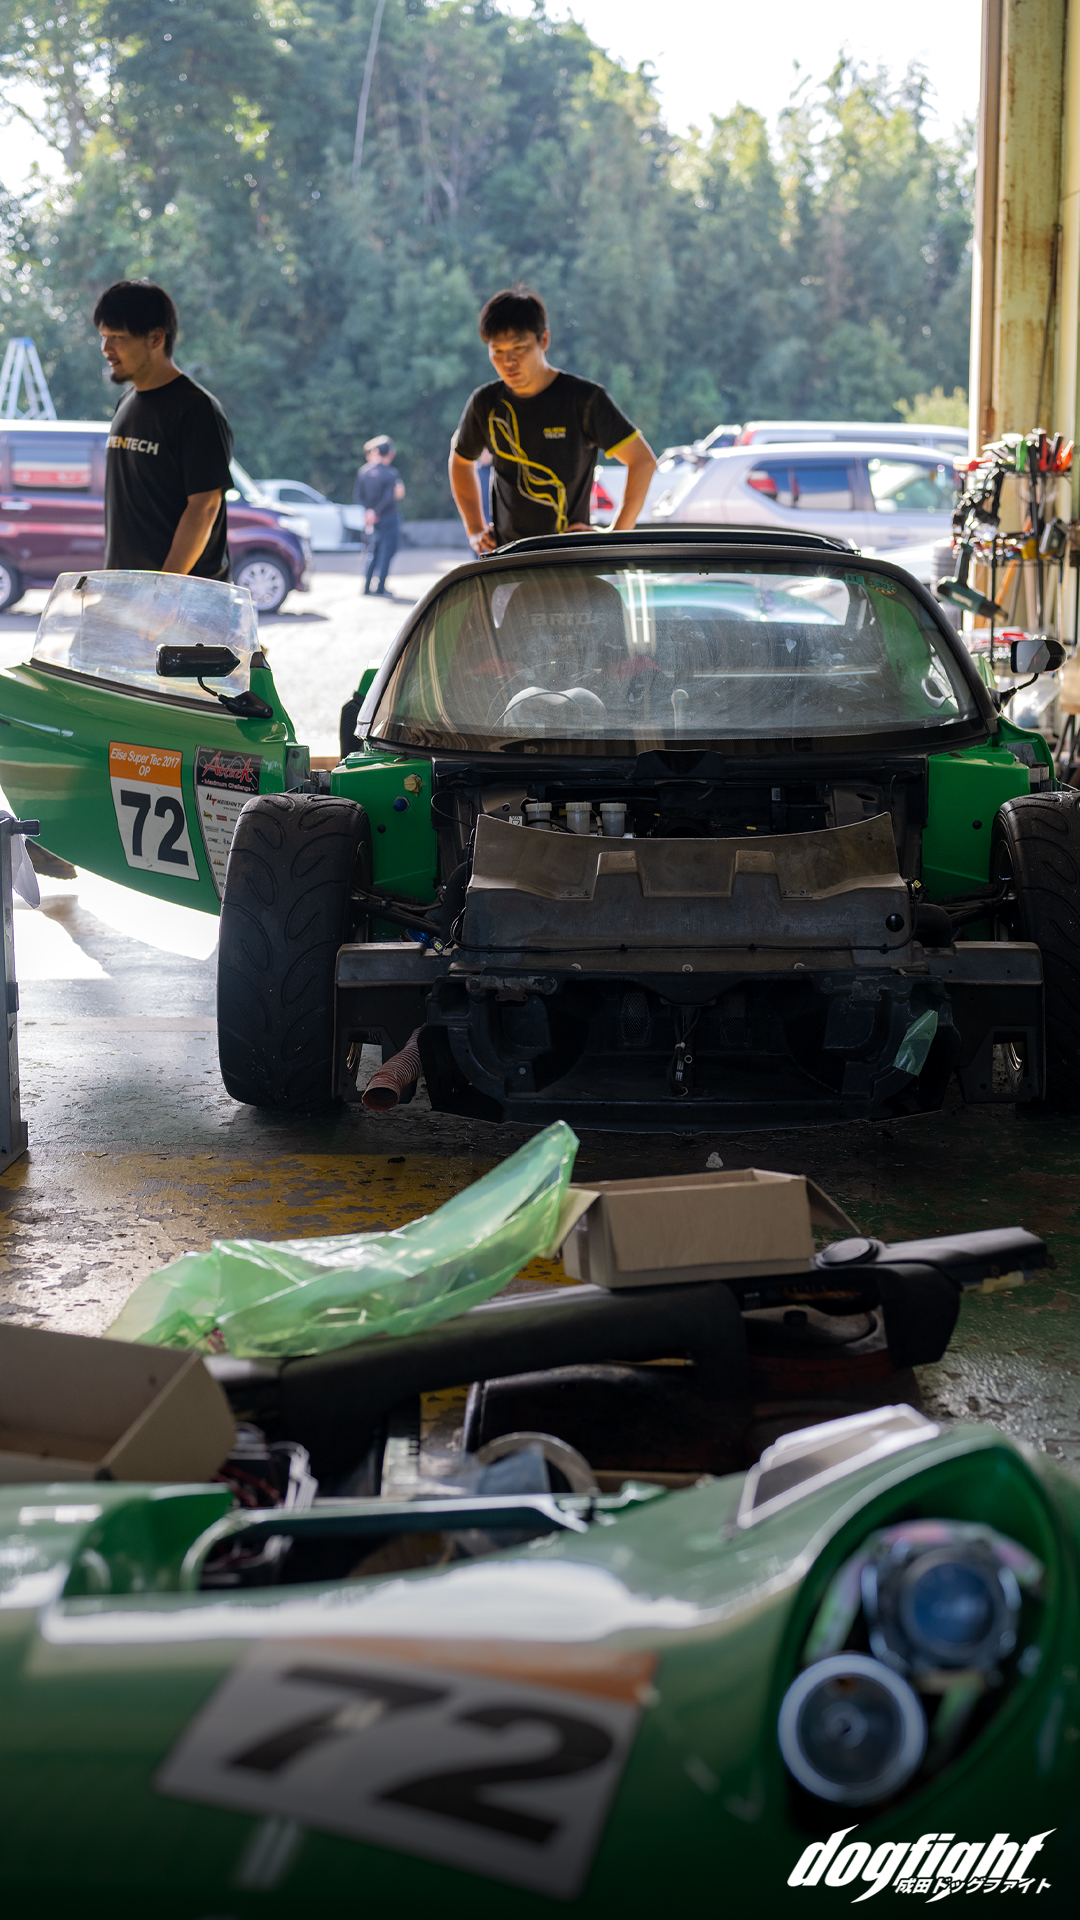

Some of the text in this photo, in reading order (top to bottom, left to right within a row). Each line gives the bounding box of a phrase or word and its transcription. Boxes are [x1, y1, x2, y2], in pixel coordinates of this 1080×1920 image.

[110, 748, 180, 768] Elise Super Tec 2017
[138, 765, 151, 776] OP
[201, 750, 254, 783] Attack
[120, 789, 189, 866] 72
[227, 1665, 613, 1845] 72
